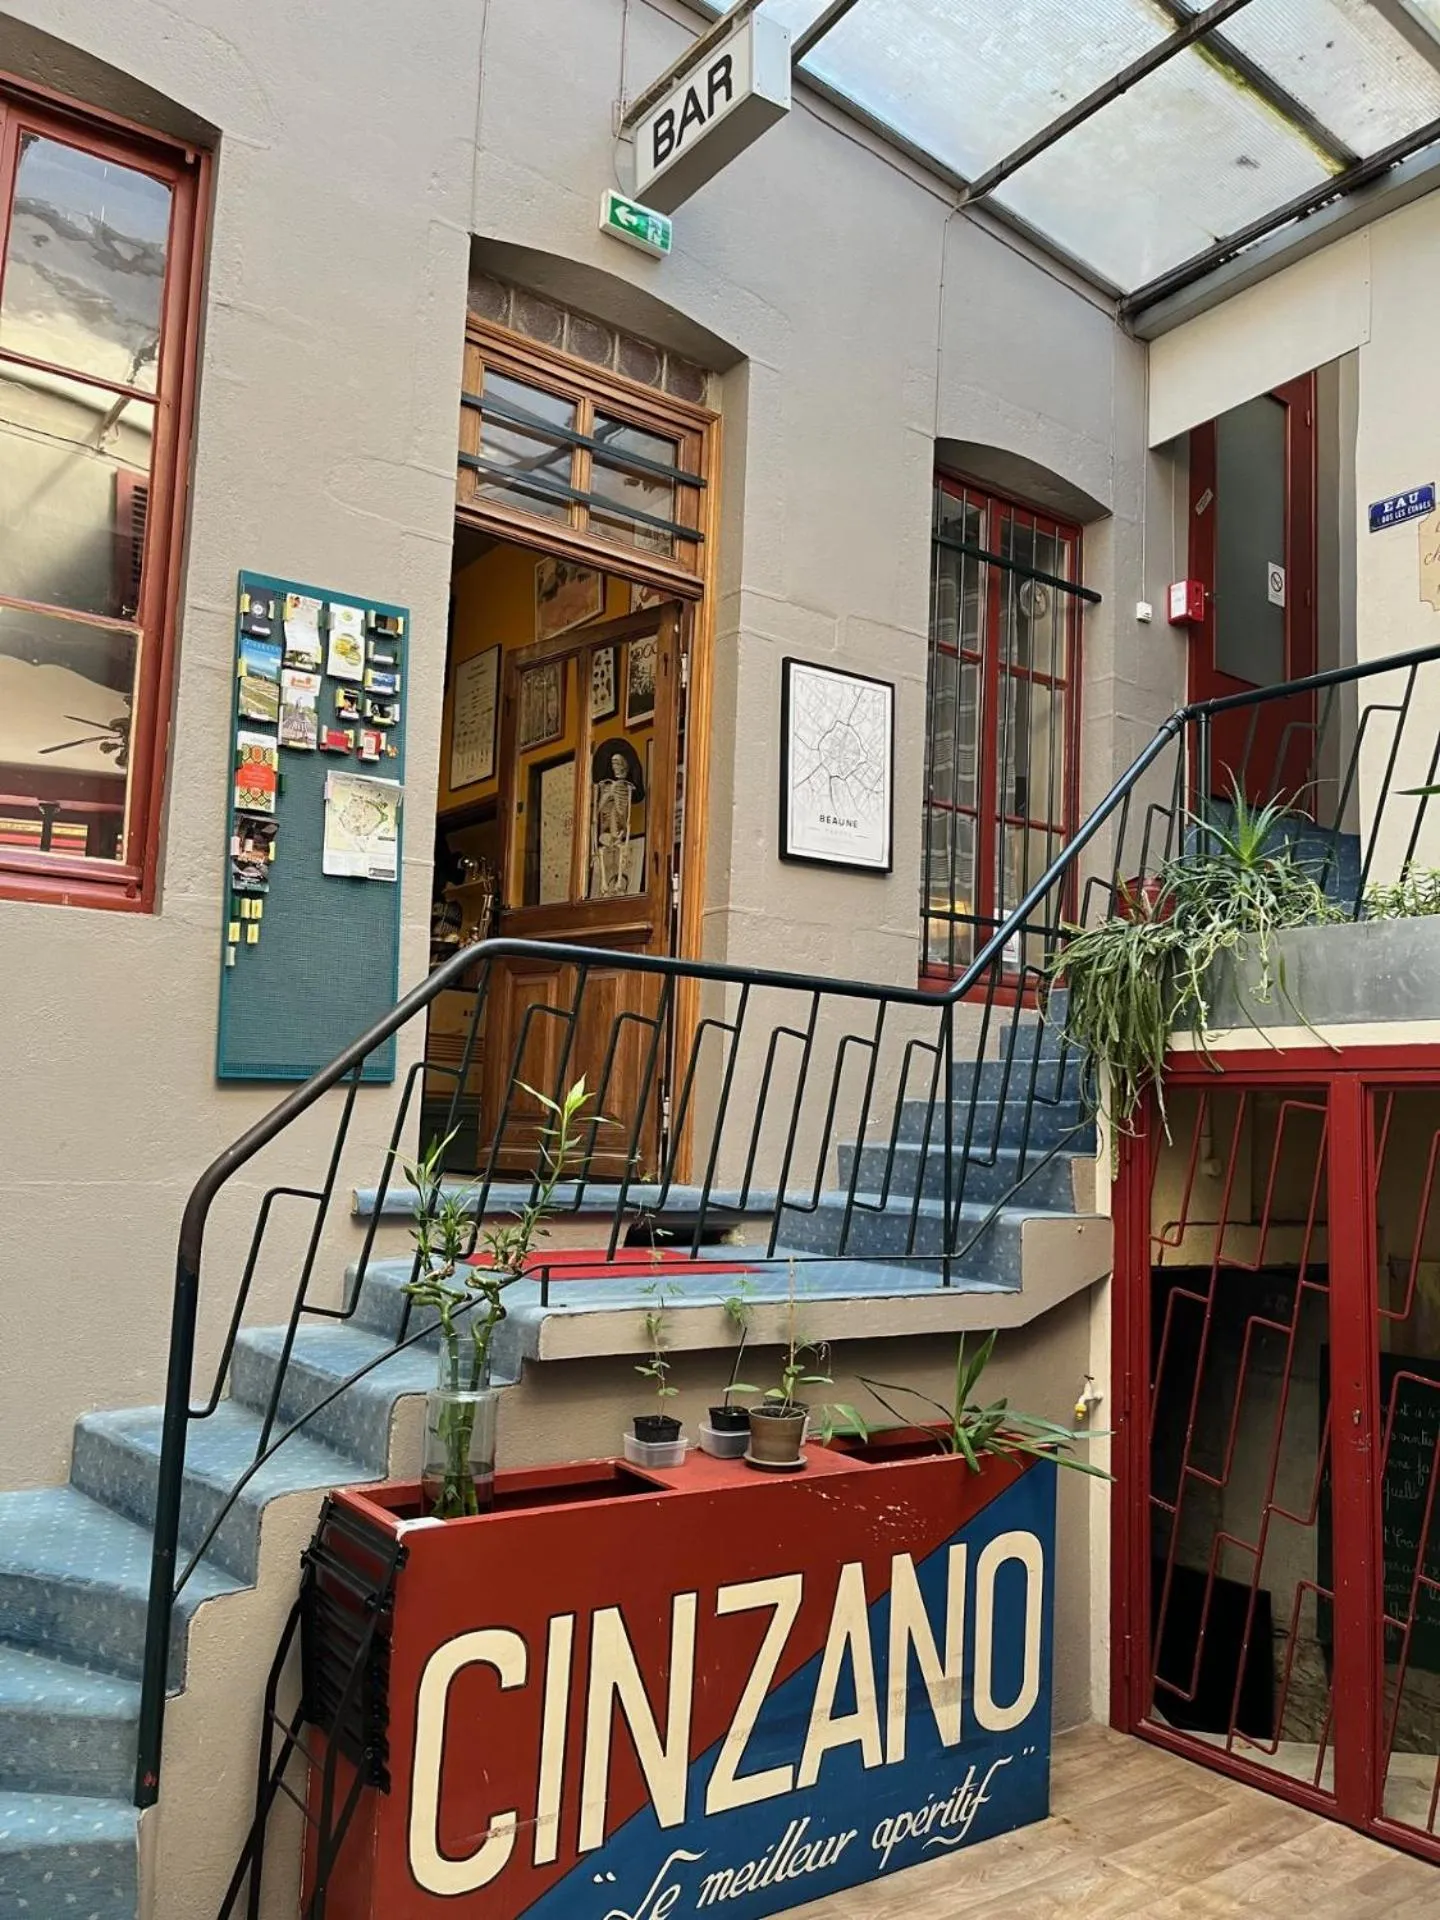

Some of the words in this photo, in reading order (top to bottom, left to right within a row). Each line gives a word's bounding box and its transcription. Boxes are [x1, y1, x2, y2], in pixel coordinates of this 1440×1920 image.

[654, 54, 732, 168] BAR
[1384, 492, 1419, 513] EAU
[819, 814, 858, 829] BEAUNE
[410, 1531, 1043, 1894] CINZANO
[696, 1816, 859, 1910] meilleur
